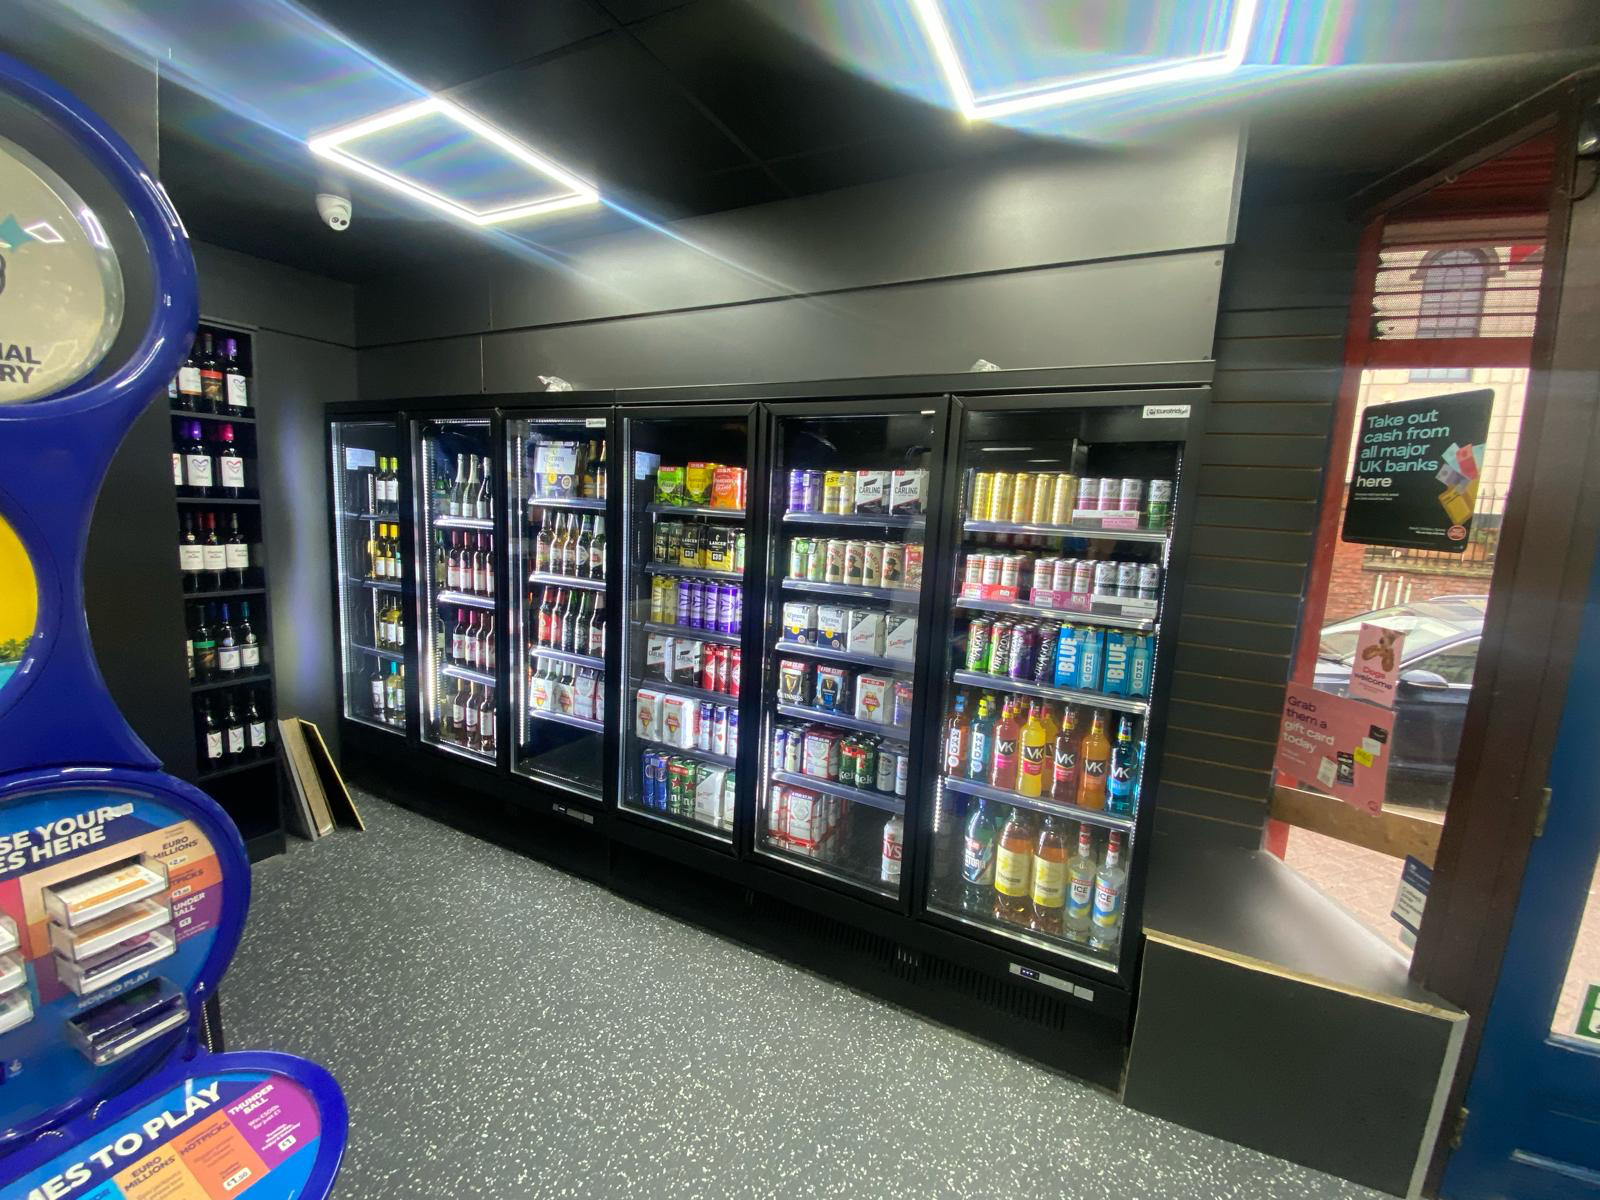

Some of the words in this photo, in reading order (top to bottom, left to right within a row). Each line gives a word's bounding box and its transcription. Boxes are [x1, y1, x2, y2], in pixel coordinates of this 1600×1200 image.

[0, 364, 34, 384] RY
[1368, 415, 1403, 429] Take
[1408, 409, 1439, 425] out
[1363, 429, 1402, 444] cash
[1406, 425, 1450, 440] from
[1360, 444, 1376, 458] all
[1379, 442, 1430, 460] major
[1359, 460, 1382, 473] UK
[1385, 458, 1438, 472] banks
[859, 486, 880, 494] CARLING
[895, 486, 917, 495] CARLING
[1356, 476, 1392, 488] here
[992, 631, 1010, 670] DRAGON
[1034, 637, 1051, 676] DRAGON
[1058, 637, 1077, 673] BLUE
[1107, 643, 1127, 680] BLUE
[1354, 673, 1393, 690] welcome
[1363, 666, 1386, 680] Dogs
[1287, 695, 1317, 713] Grab
[1286, 707, 1318, 725] them
[1319, 720, 1328, 729] a
[1283, 732, 1317, 754] today
[1284, 721, 1305, 734] gift
[1306, 728, 1336, 746] card
[996, 740, 1014, 753] VK
[1027, 747, 1043, 760] VK
[1056, 753, 1075, 766] VK
[1085, 760, 1104, 774] VK
[1112, 767, 1130, 779] VK
[0, 830, 32, 855] SE
[35, 806, 114, 841] YOUR
[31, 825, 106, 863] HERE
[153, 839, 199, 859] MILLIONS
[162, 836, 189, 850] EURO
[1073, 885, 1089, 894] ICE
[1097, 892, 1112, 903] ICE
[173, 892, 206, 911] UNDER
[78, 994, 105, 1009] HOW
[108, 985, 122, 996] TO
[124, 971, 151, 988] PLAY
[227, 1084, 274, 1115] THUNDER
[243, 1097, 269, 1114] BALL
[27, 1162, 92, 1200] ES
[89, 1133, 142, 1169] TO
[143, 1081, 221, 1140] PLAY
[124, 1154, 176, 1192] MILLIONS
[131, 1156, 162, 1177] EURO
